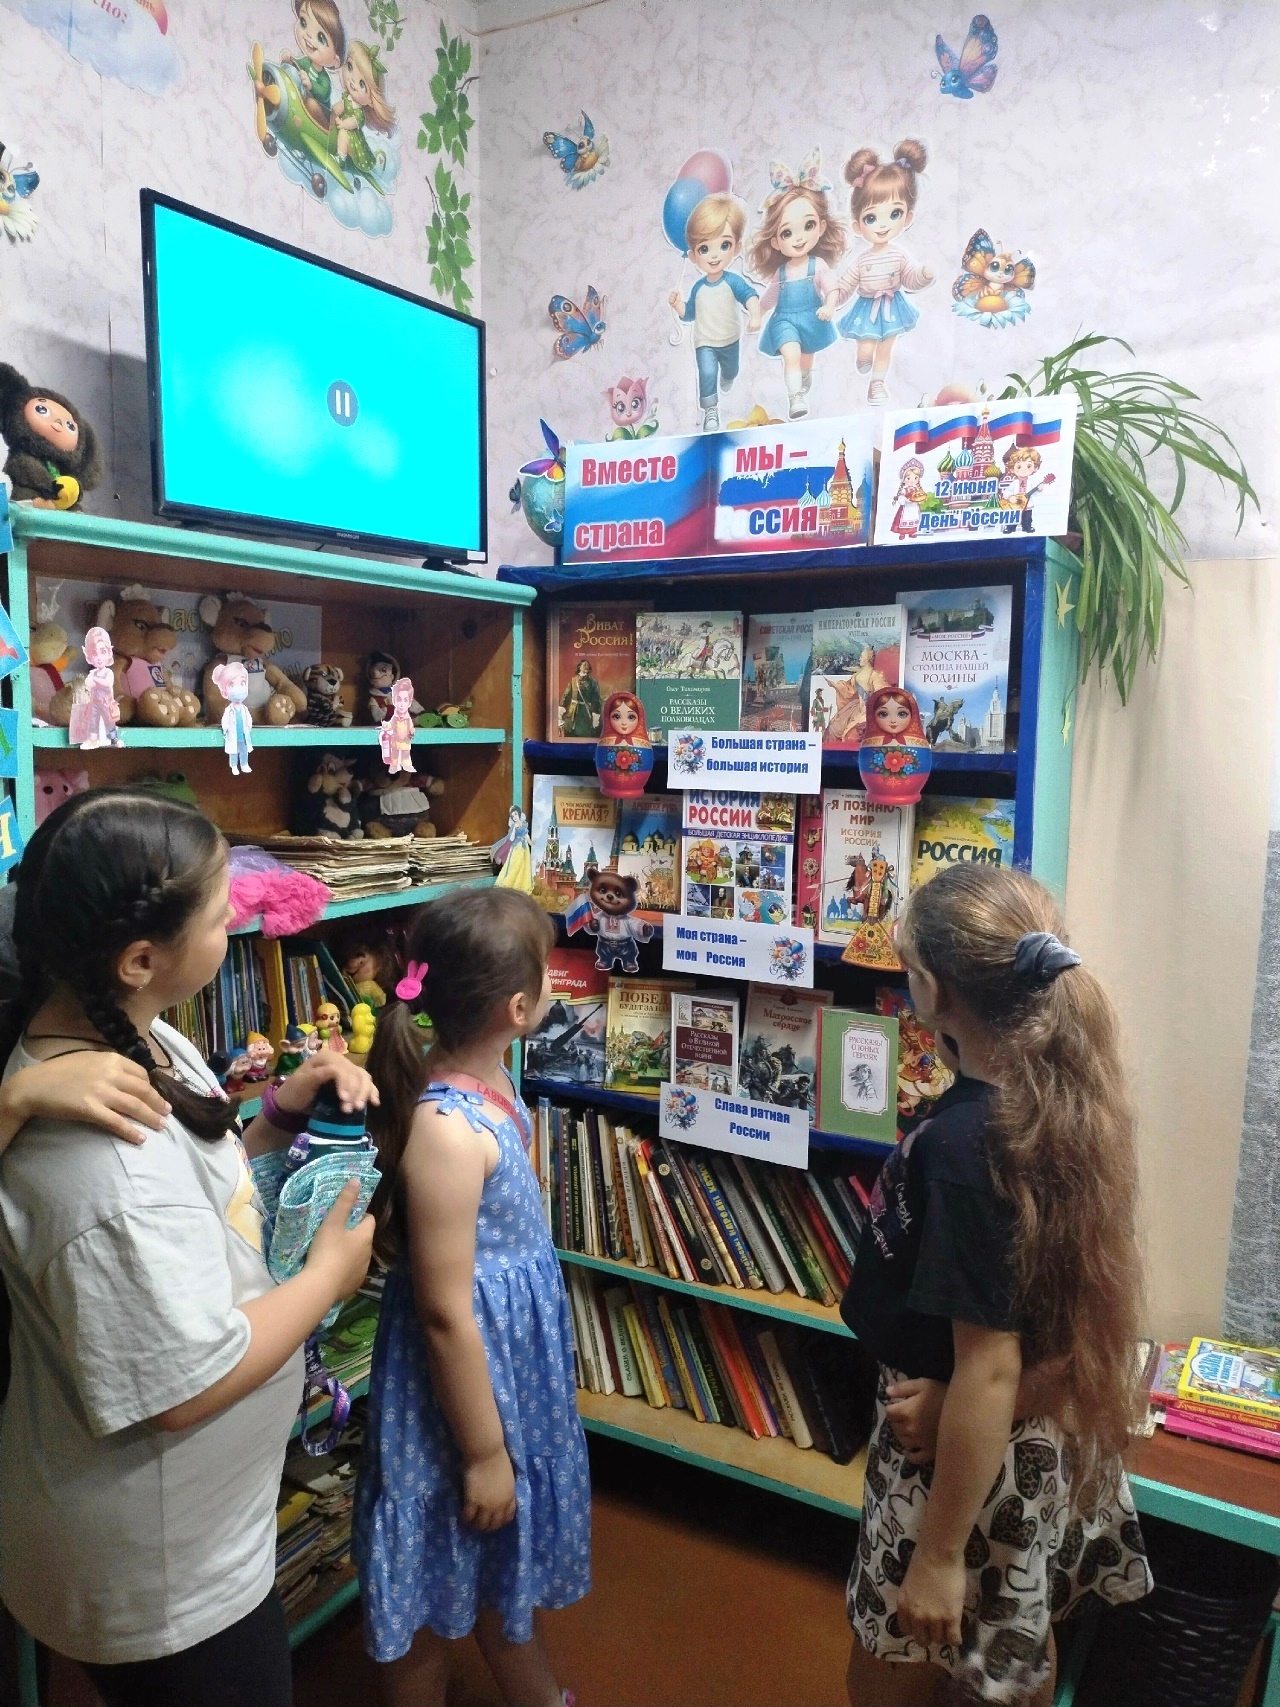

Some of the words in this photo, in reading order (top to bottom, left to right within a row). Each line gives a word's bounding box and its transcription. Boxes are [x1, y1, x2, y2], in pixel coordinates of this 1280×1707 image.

[582, 455, 676, 487] Вместе
[934, 481, 950, 497] 12
[952, 480, 997, 496] июня
[919, 512, 959, 531] День
[963, 510, 1021, 527] России
[575, 519, 664, 551] страна
[871, 616, 896, 628] РОССИЯ
[921, 650, 979, 662] МОСКВА
[912, 663, 954, 671] СТОЛИЦА
[956, 662, 989, 671] НАШЕЙ
[923, 673, 977, 684] РОДИНЫ
[669, 698, 707, 706] РАССКАЗЫ
[670, 706, 715, 716] ВЕЛИКИХ
[661, 716, 715, 724] ПОЛКОВОДЦАХ
[711, 736, 763, 750] Большая
[765, 738, 807, 751] страна
[706, 758, 758, 772] большая
[759, 761, 809, 775] история
[689, 790, 760, 807] ИСТОРИЯ
[831, 799, 839, 810] Я
[562, 808, 609, 822] КРЕМЛЯ?
[688, 805, 752, 828] РОССИИ
[850, 814, 875, 825] МИР
[687, 829, 715, 837] БОЛЬШАЯ
[716, 831, 741, 840] ДЕТСКАЯ
[741, 833, 788, 842] ЭНЦИКЛОПЕДИЯ
[840, 828, 882, 838] ИСТОРИЯ
[917, 840, 1002, 868] РОССИЯ
[676, 927, 698, 940] Моя
[699, 931, 738, 945] страна
[676, 950, 697, 961] моя
[706, 951, 746, 967] Россия
[547, 969, 569, 977] ДВИГ
[550, 978, 588, 988] ИНГРАДА
[619, 991, 668, 1006] ПОБЕД
[848, 1035, 883, 1047] РАССКАЗЫ
[714, 1097, 748, 1116] Слава
[750, 1105, 791, 1124] ратная
[729, 1121, 771, 1142] России
